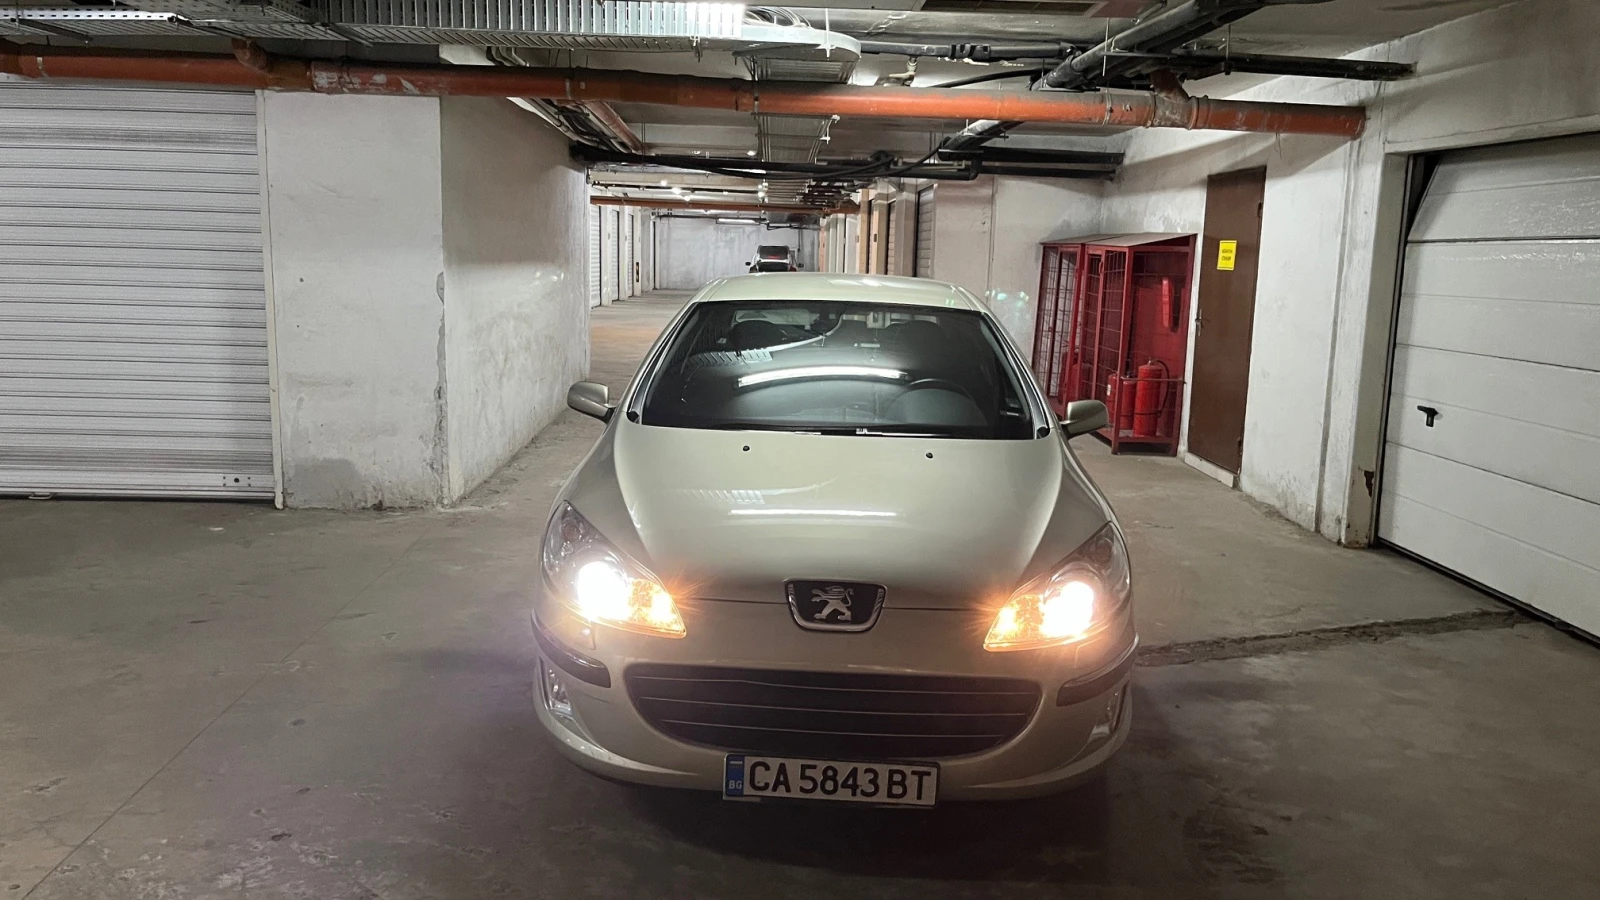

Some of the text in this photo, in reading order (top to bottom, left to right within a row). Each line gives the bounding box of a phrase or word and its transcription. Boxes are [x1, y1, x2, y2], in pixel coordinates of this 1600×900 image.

[728, 780, 743, 790] BG
[749, 761, 932, 801] CA 5843 BT
